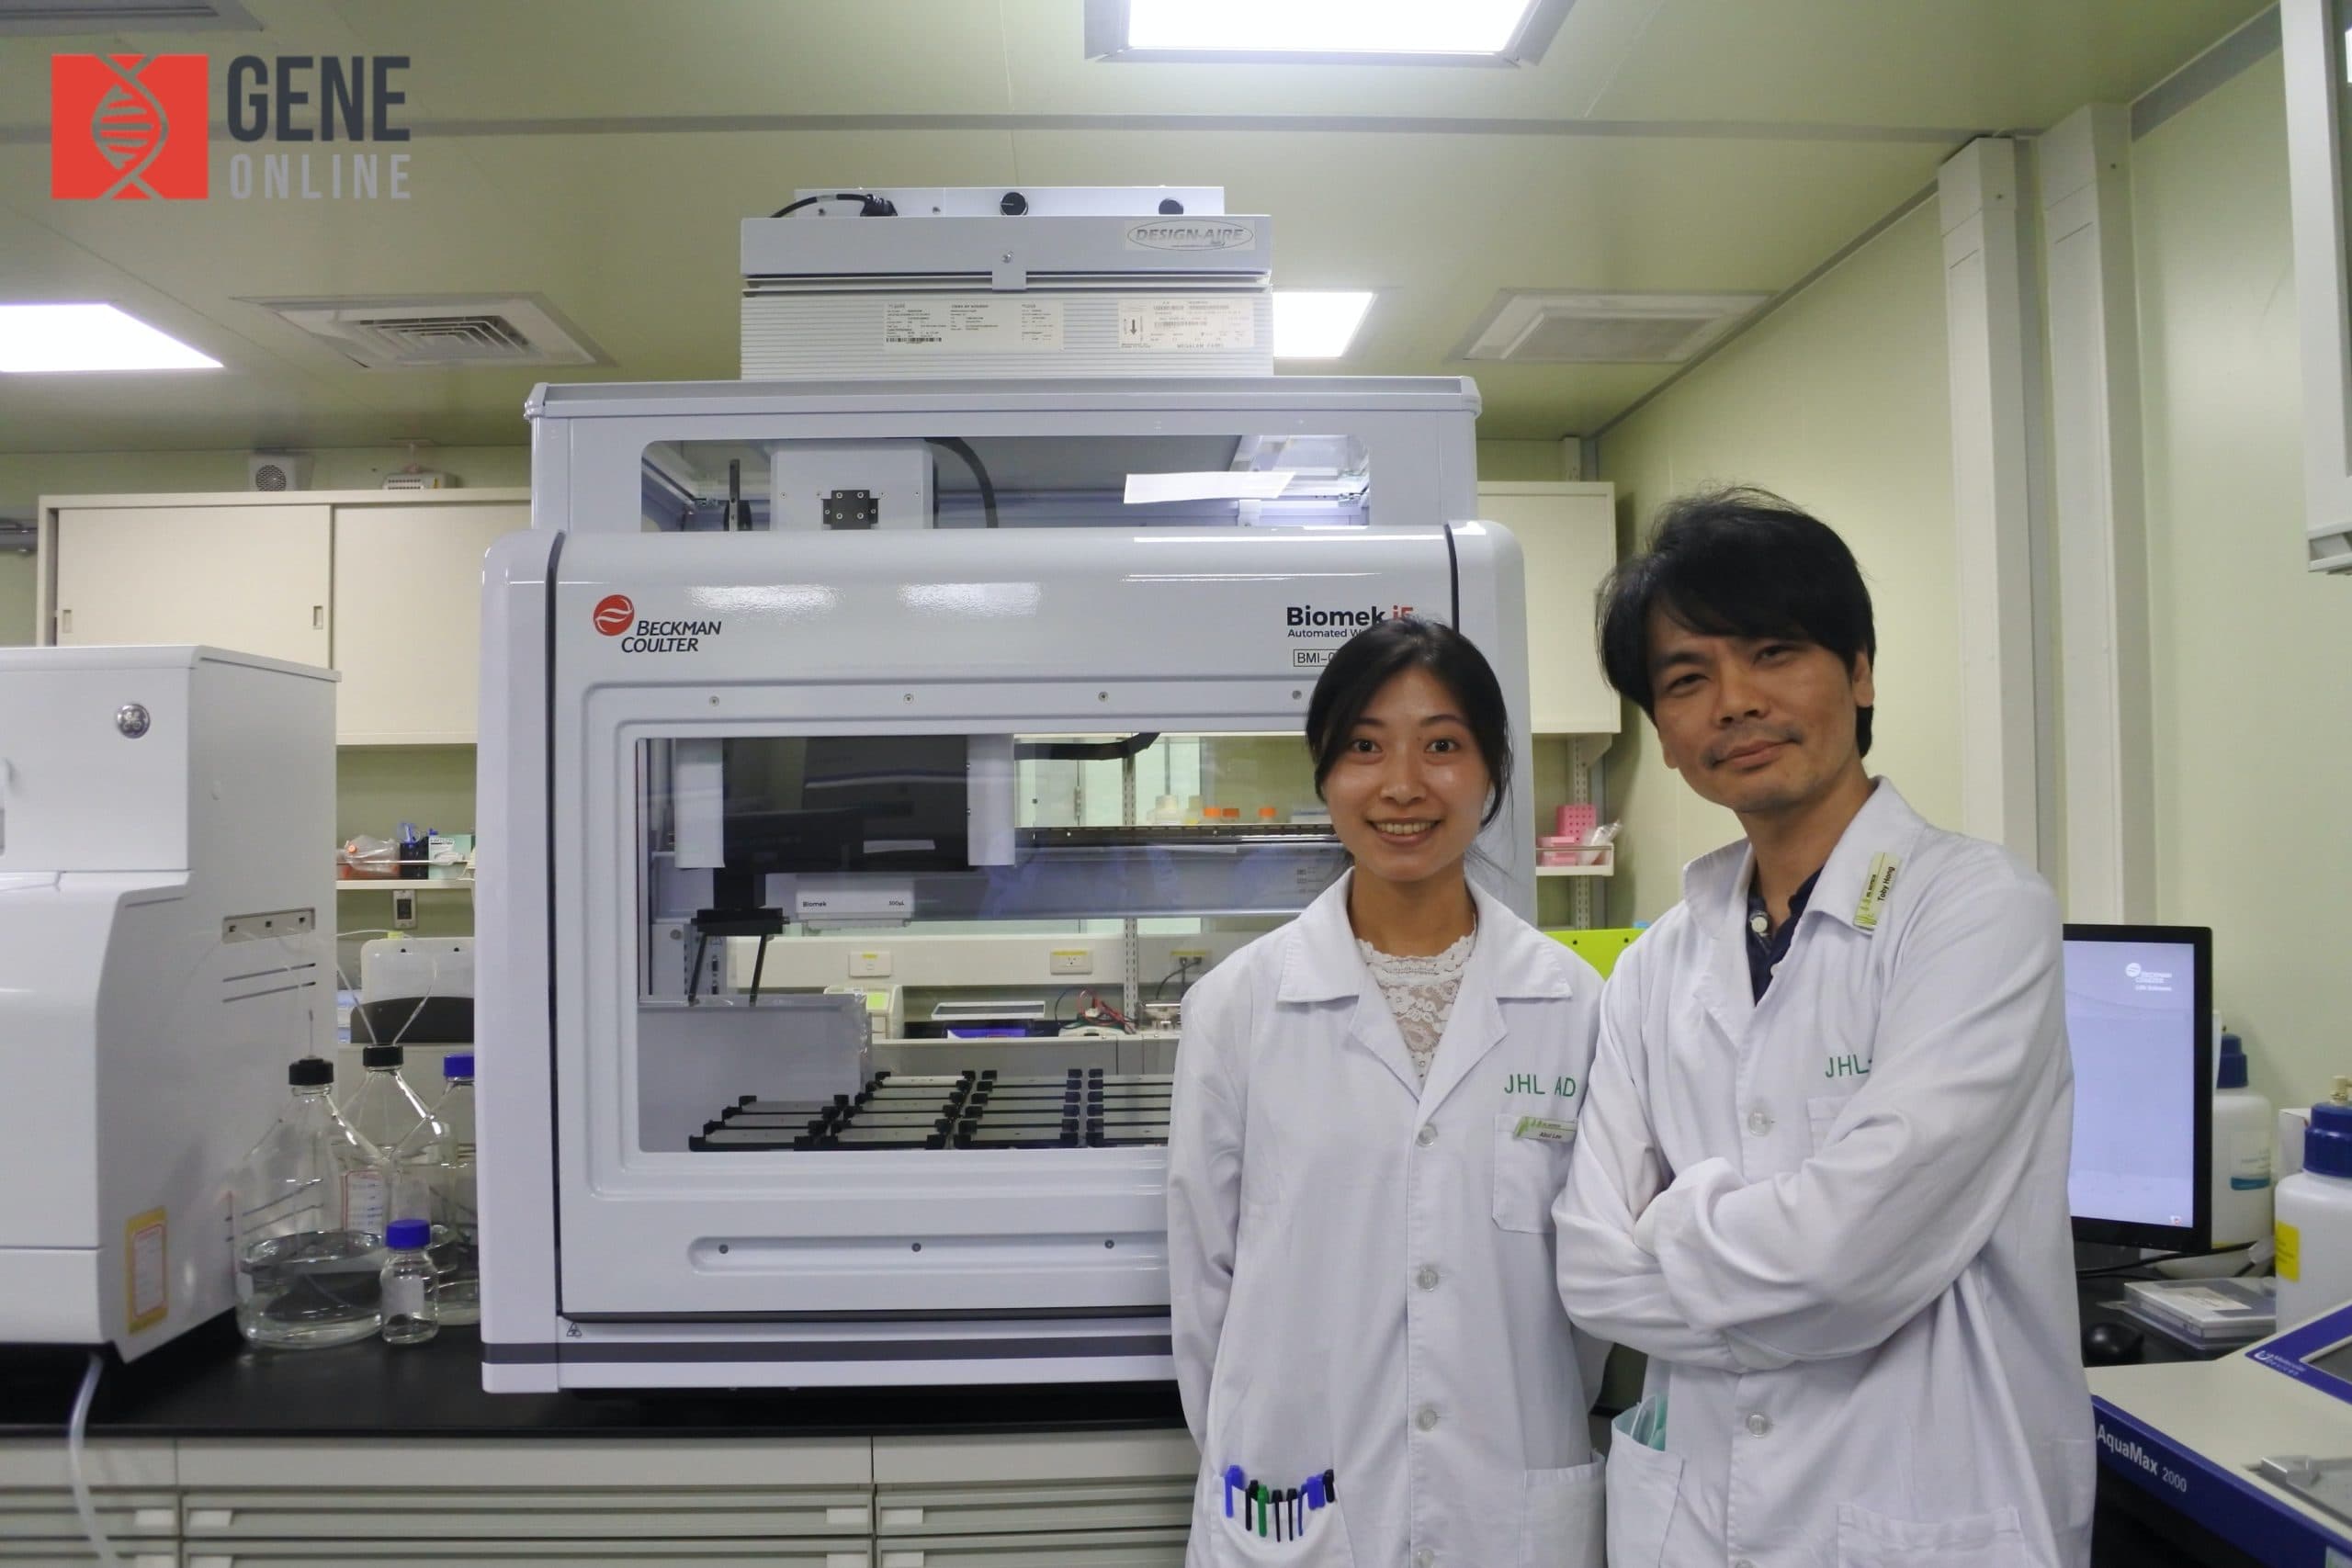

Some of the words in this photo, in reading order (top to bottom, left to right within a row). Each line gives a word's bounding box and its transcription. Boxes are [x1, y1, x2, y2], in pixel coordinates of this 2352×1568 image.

[1136, 229, 1244, 242] DESIGN-AIRE
[1286, 605, 1385, 626] Biomek
[636, 620, 722, 636] BECKMAN
[1287, 629, 1347, 638] Automated
[621, 637, 699, 653] COULTER
[802, 900, 827, 908] Biomek
[1504, 1074, 1545, 1095] JHL
[1555, 1076, 1576, 1097] AD
[2097, 1424, 2158, 1476] AquaMax
[2162, 1467, 2188, 1493] 2000
